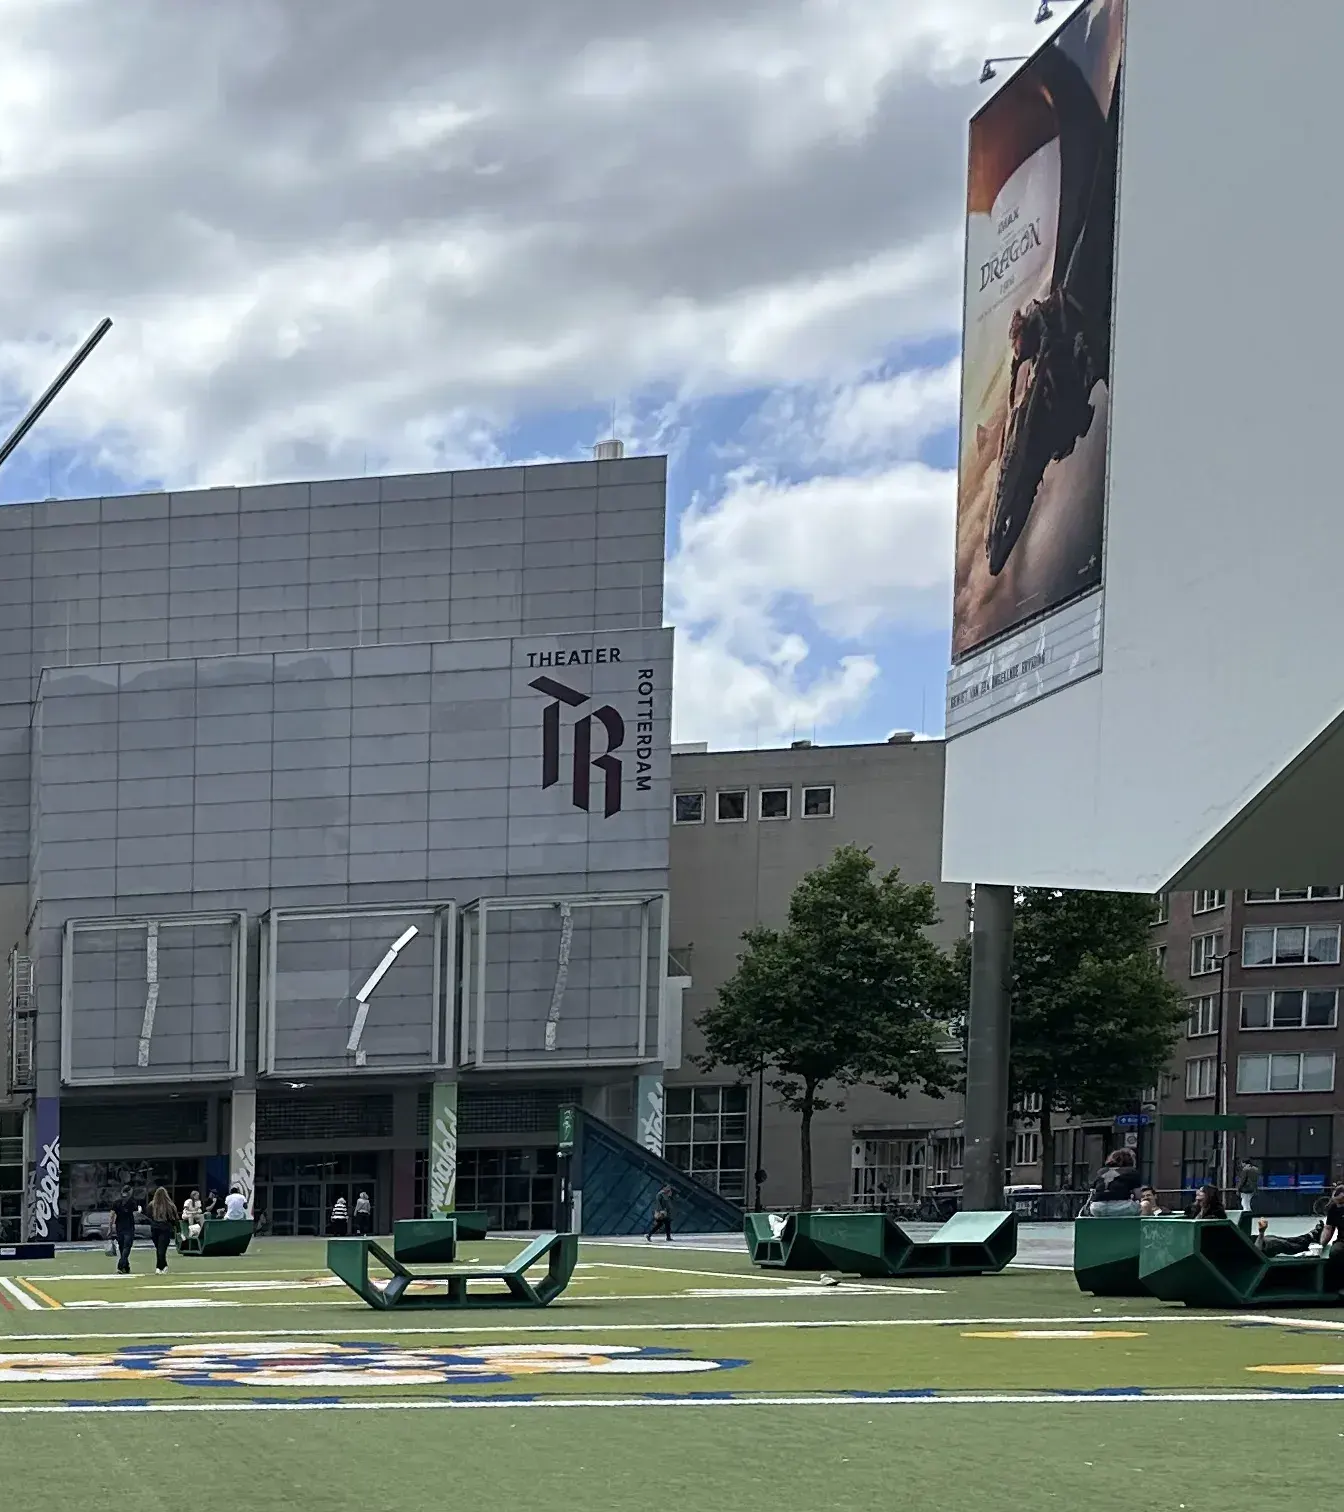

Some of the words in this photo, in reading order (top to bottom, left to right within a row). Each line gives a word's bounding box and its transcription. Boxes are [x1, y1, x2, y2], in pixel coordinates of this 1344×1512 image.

[979, 217, 1042, 293] DRAGON
[526, 647, 622, 668] THEATER
[527, 675, 625, 820] TR
[635, 668, 654, 792] ROTTERDAM
